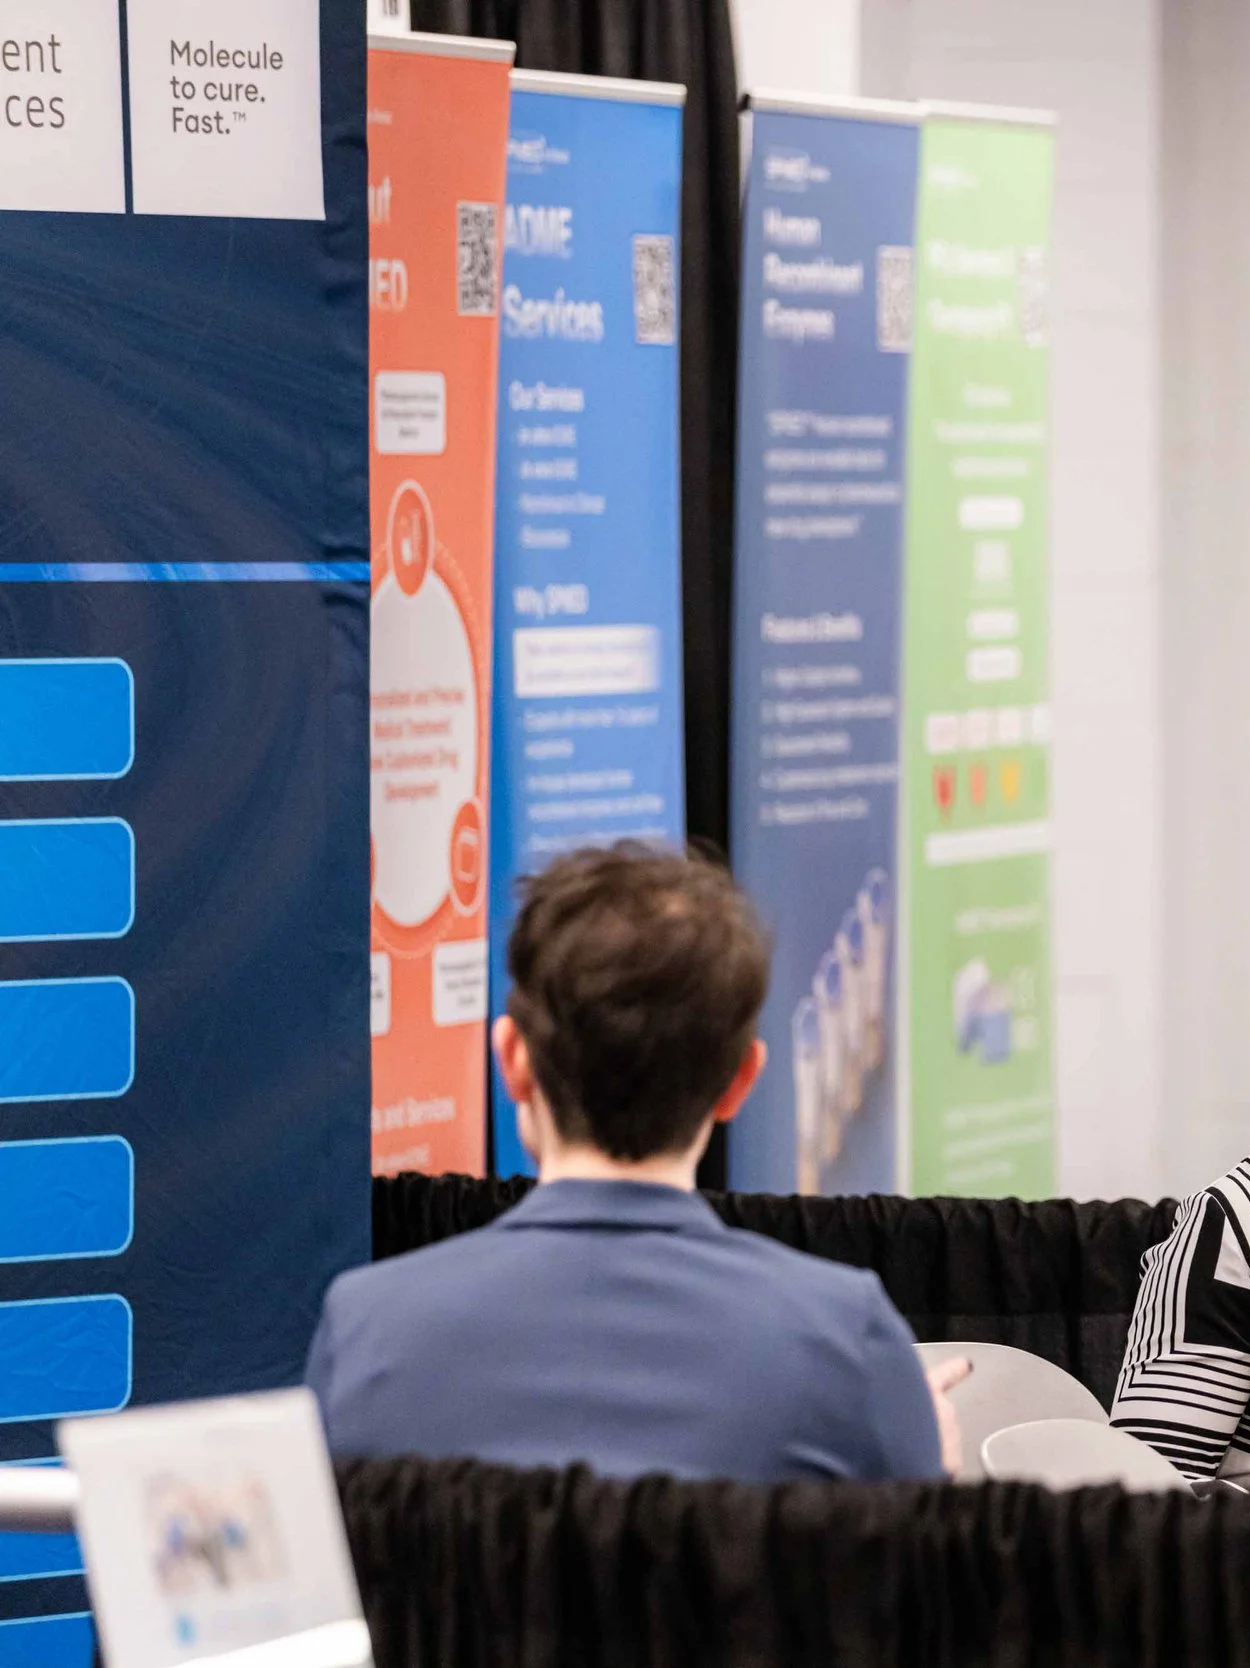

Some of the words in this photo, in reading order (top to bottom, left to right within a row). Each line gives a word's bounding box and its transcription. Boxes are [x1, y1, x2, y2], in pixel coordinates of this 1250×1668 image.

[1, 34, 62, 74] ent
[170, 40, 284, 70] Molecule
[170, 76, 196, 101] to
[203, 79, 266, 103] cure.
[5, 94, 65, 129] ces
[502, 284, 605, 340] Services
